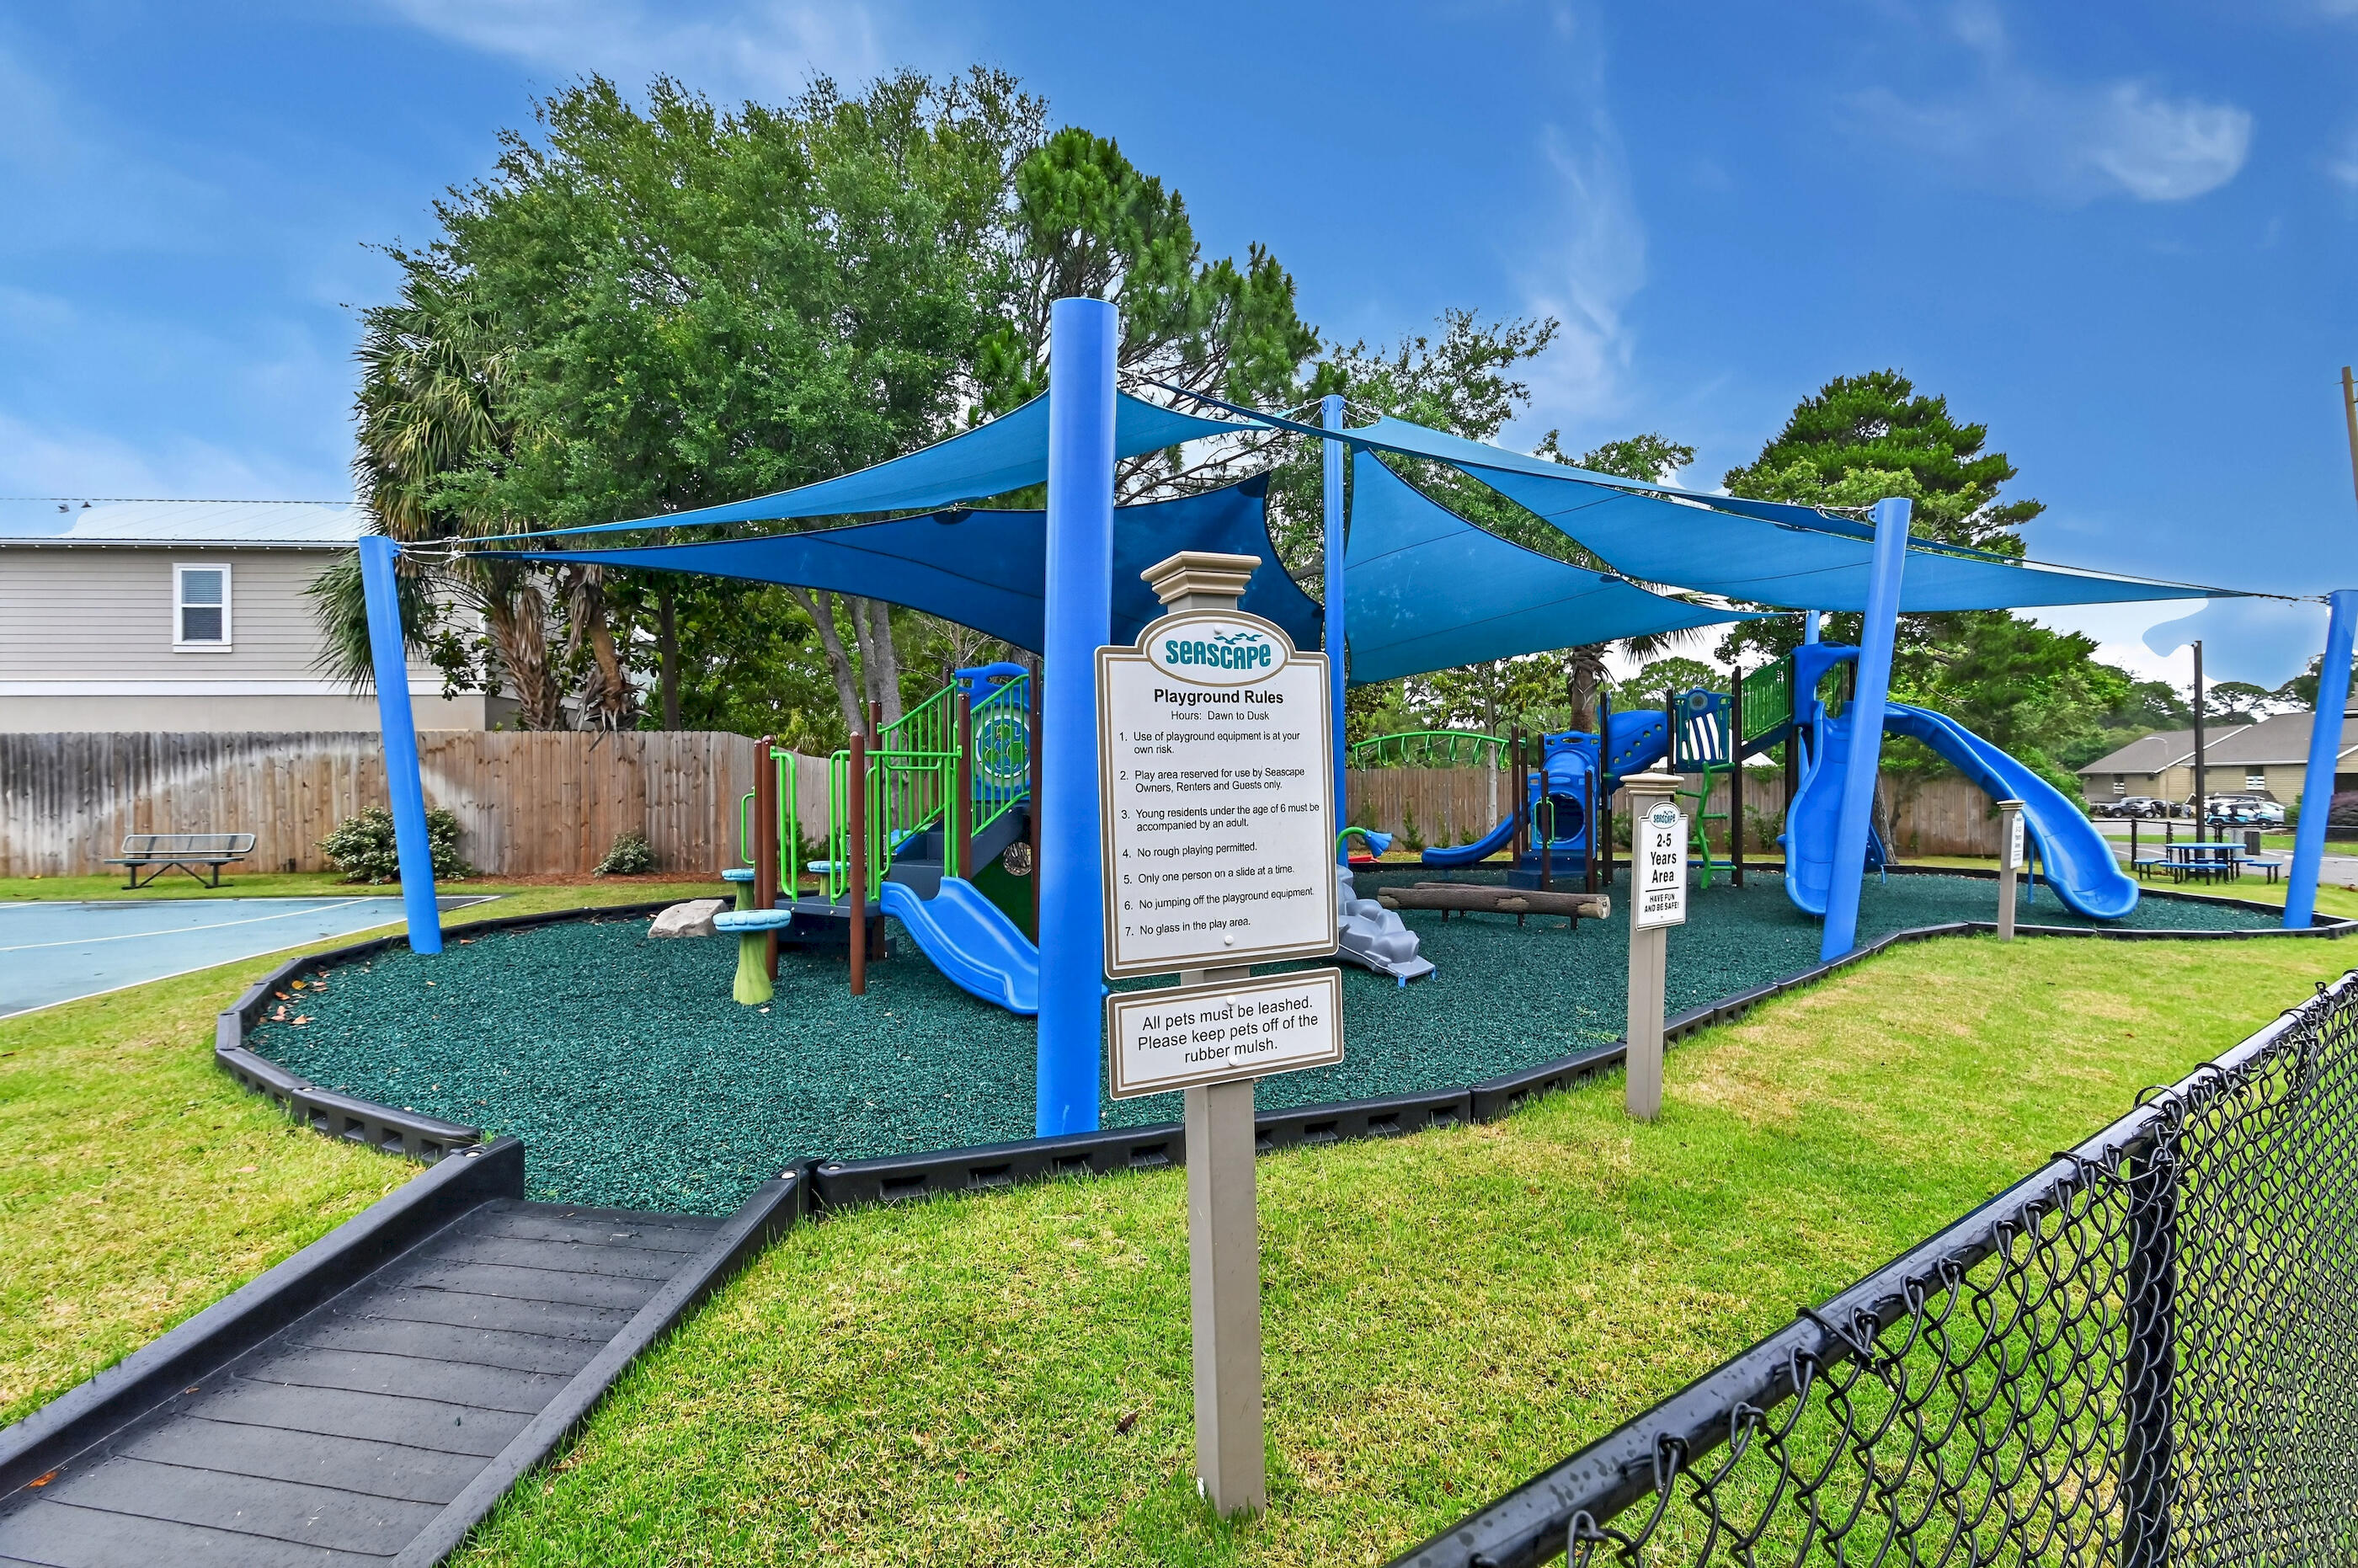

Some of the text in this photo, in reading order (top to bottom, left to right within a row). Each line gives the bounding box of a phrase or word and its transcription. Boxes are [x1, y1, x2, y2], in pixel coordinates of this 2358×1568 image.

[1154, 689, 1283, 707] Playground Rules
[1171, 711, 1270, 721] Hours: Dawn to Dusk
[1119, 731, 1300, 744] 1. Use of playground equipment is at your
[1155, 744, 1175, 754] risk.
[1120, 771, 1128, 781] 2.
[1134, 771, 1155, 782] Play
[1158, 771, 1178, 780] area
[1180, 769, 1219, 779] reserved
[1220, 769, 1233, 778] for
[1252, 768, 1262, 779] by
[1265, 767, 1305, 779] Seascape
[1135, 780, 1283, 794] Owners, Renters and Guests only.
[1121, 803, 1320, 821] 3. Young residents under the age of 6 must be
[1136, 818, 1249, 833] accompanied by an adult.
[1656, 833, 1672, 847] 2-5
[1123, 842, 1257, 858] 4. No rough playing permitted.
[1650, 851, 1677, 866] Years
[1123, 864, 1294, 885] 5. Only one person on a slide at a time.
[1651, 869, 1674, 884] Area
[1124, 887, 1315, 910] 6. No jumping off the playground equipment.
[1649, 893, 1675, 903] HAVE FUN
[1644, 902, 1679, 913] AND BE SAFE!
[1125, 917, 1251, 936] 7. No glass in the play area.
[1142, 995, 1313, 1032] All pets must be leashed.
[1139, 1013, 1319, 1051] Please keep pets off of the
[1185, 1038, 1278, 1063] rubber mulsh.
